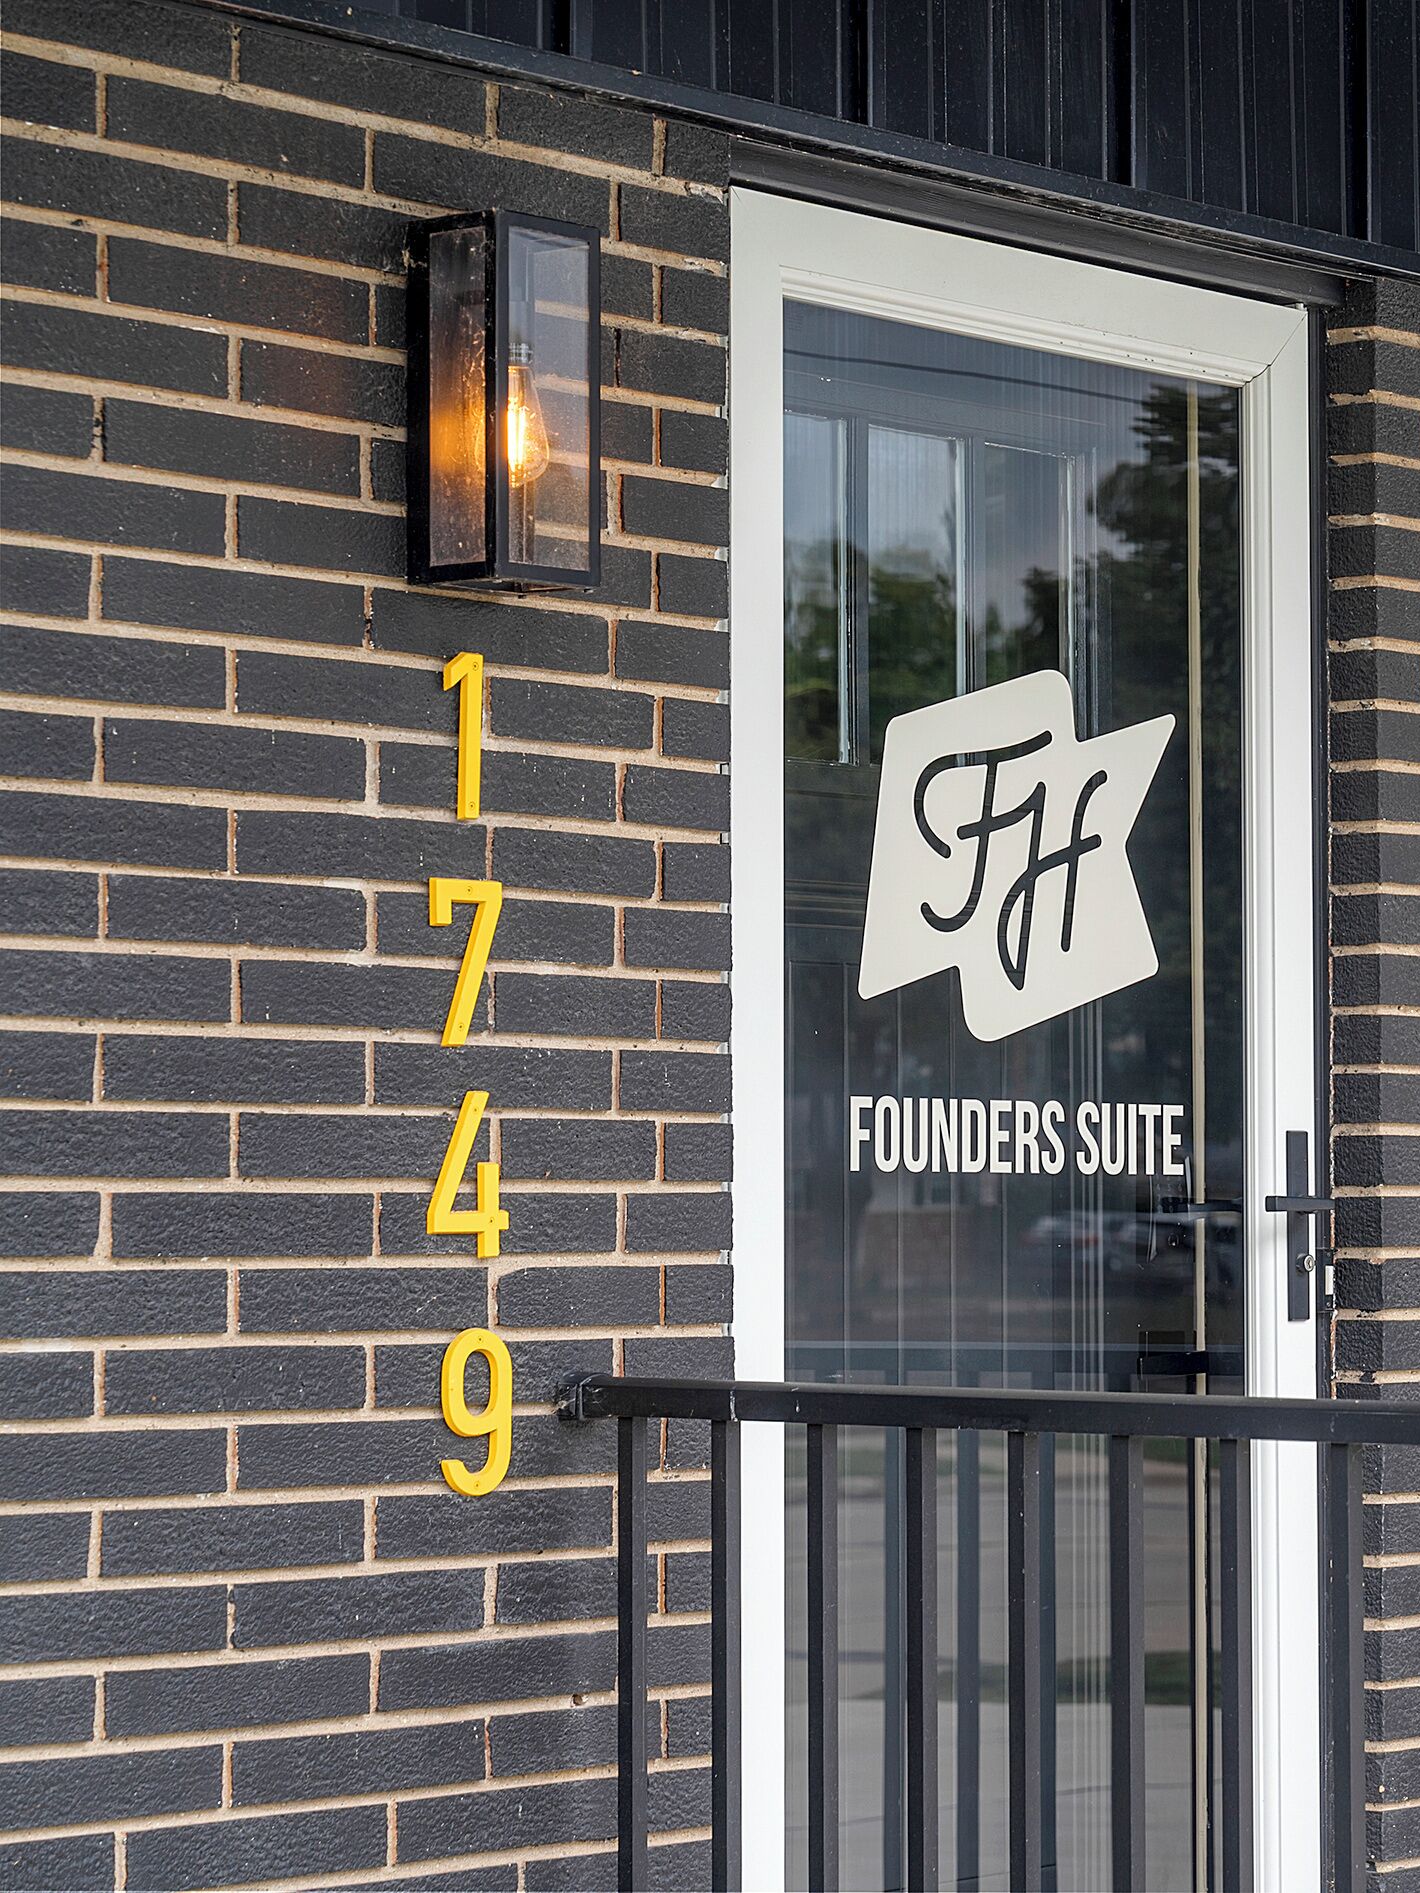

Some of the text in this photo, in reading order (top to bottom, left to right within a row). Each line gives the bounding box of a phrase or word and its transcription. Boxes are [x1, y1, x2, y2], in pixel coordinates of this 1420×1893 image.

[427, 652, 512, 1496] 1749
[849, 1095, 1184, 1176] FOUNDERS SUITE
